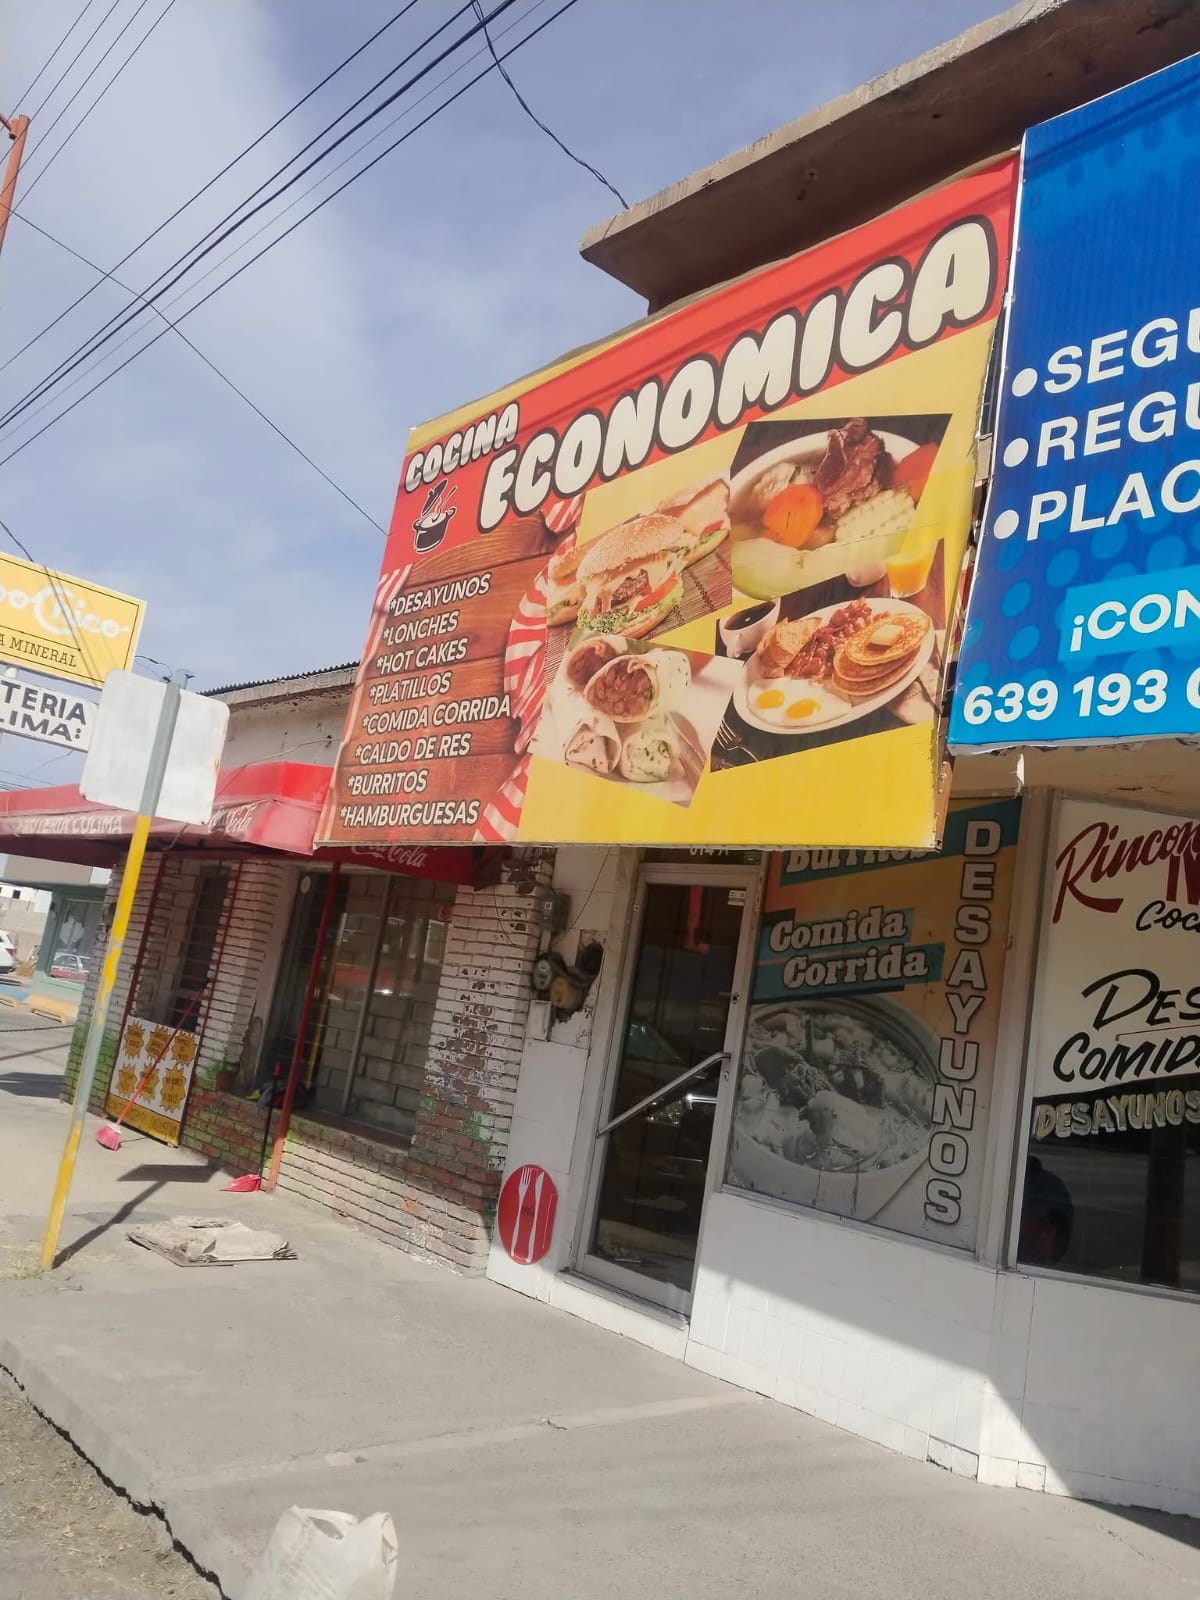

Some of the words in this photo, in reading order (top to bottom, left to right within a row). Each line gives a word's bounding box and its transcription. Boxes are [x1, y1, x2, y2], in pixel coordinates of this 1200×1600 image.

[477, 215, 997, 532] ECONOMICA
[404, 403, 520, 493] COCINA
[9, 637, 77, 667] MINERAL
[416, 638, 469, 667] CAKES
[0, 680, 86, 725] TERIA
[432, 694, 512, 727] CORRIDA
[963, 679, 1058, 726] 639
[1072, 669, 1168, 718] 193
[0, 710, 81, 742] IMA:
[414, 736, 436, 760] DE
[439, 732, 472, 758] RES
[769, 905, 908, 952] Comida
[1136, 900, 1200, 931] Coc
[783, 944, 929, 989] Corrida
[924, 820, 1000, 1226] DESAYUNOS
[1053, 1031, 1200, 1083] COMID
[1032, 1089, 1200, 1141] DESAYUNOS
